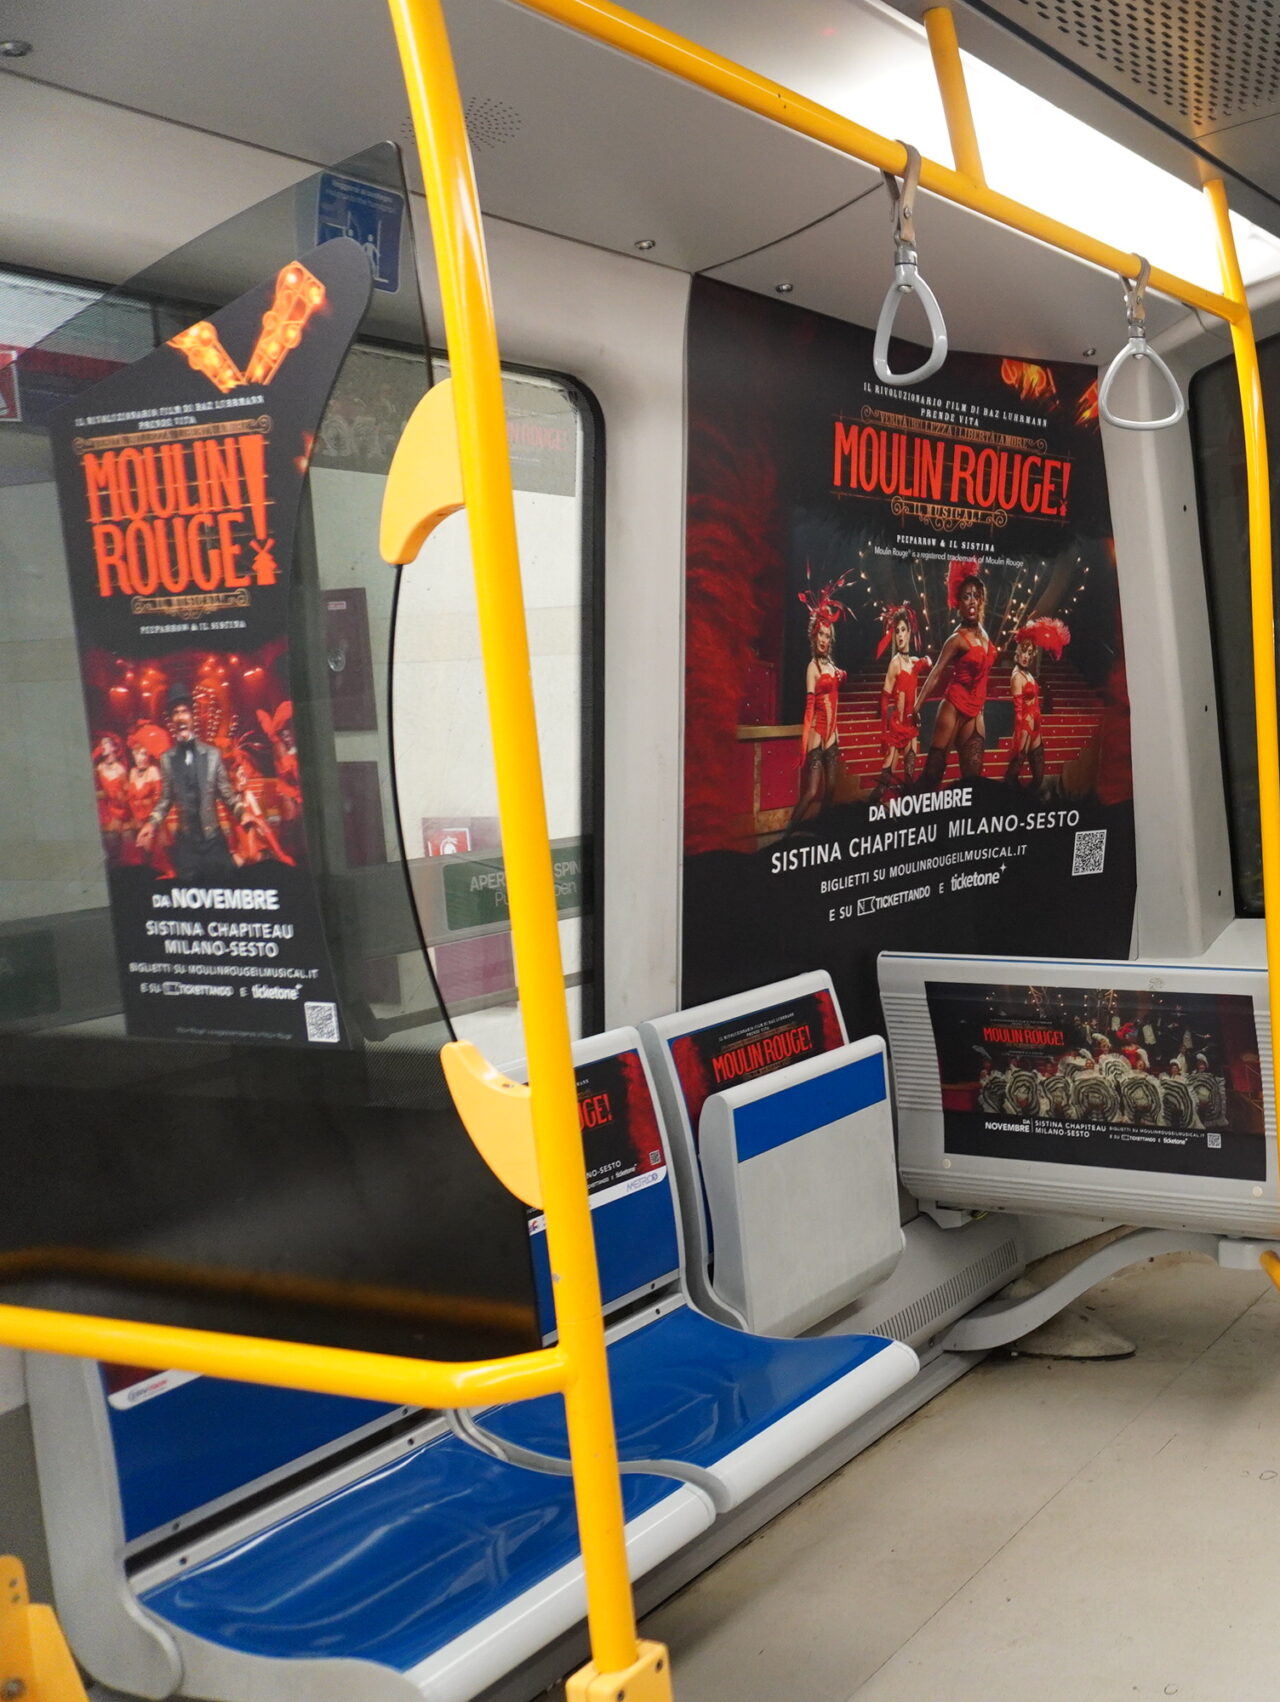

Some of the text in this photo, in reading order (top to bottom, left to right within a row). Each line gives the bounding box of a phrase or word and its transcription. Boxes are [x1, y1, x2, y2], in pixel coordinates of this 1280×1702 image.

[864, 382, 1047, 427] IL RIVOLUZIONARIO FILM DI BAZ LUHRMANN
[920, 408, 980, 427] PRENDE VITA
[833, 421, 1072, 517] MOULIN ROUGE!
[84, 437, 242, 524] MOULIN
[897, 534, 995, 552] PEEPARROW & IL SISTINA
[874, 546, 892, 555] Moulin
[921, 552, 946, 561] registered
[985, 556, 1005, 565] Moulin
[1006, 558, 1024, 568] Rouge
[869, 788, 973, 822] DA NOVEMBRE
[771, 809, 1080, 874] SISTINA CHAPITEAU MILANO-SESTO
[470, 861, 579, 892] APER SPIN
[820, 844, 1028, 894] BIGLIETTI SU MOULINROUGEILMUSICAL.IT
[153, 888, 280, 910] DA NOVEMBRE
[829, 872, 1000, 921] E SU TICKETTANDO E ticketone
[146, 920, 294, 939] SISTINA CHAPITEAU
[164, 939, 279, 957] MILANO-SESTO
[983, 1027, 1064, 1046] MOULIN ROUGE!
[712, 1042, 764, 1083] MOULIN
[763, 1025, 812, 1063] ROUGE!
[985, 1121, 1030, 1133] NOVEMBRE
[1035, 1120, 1106, 1132] SISTINA CHAPITEAU
[1035, 1127, 1090, 1138] MILANO-SESTO
[586, 1160, 622, 1178] NO-SESTO
